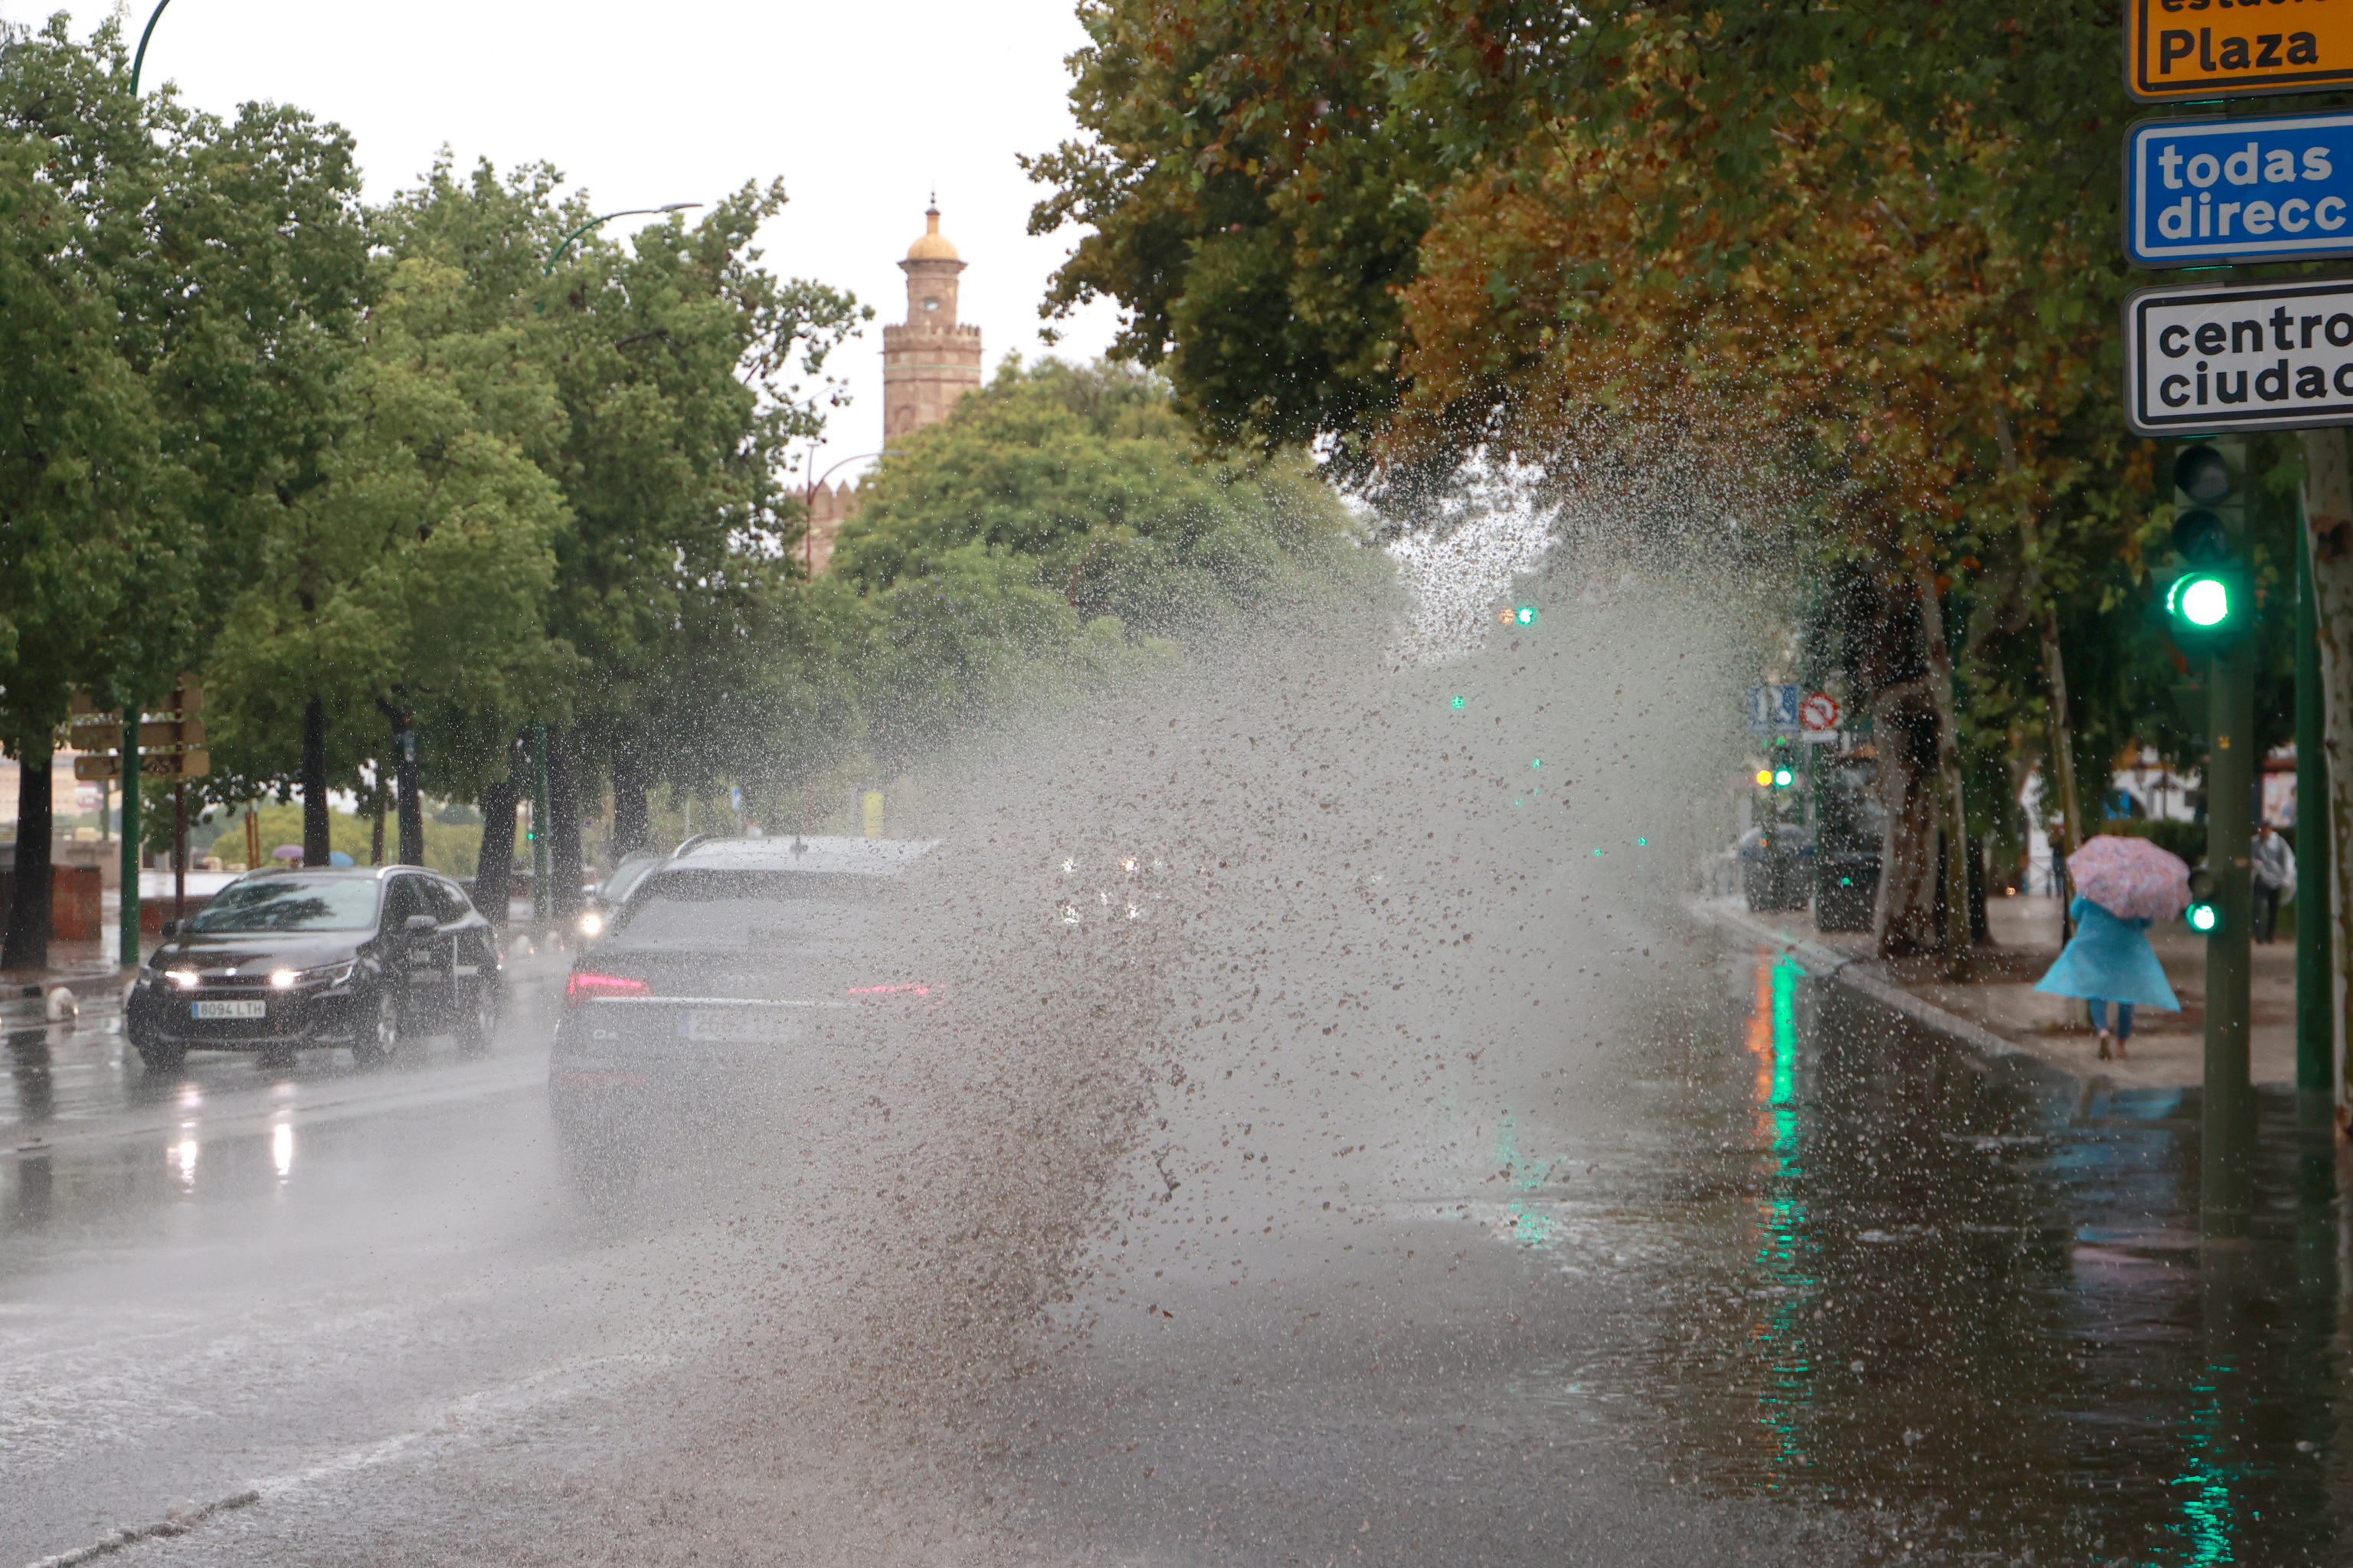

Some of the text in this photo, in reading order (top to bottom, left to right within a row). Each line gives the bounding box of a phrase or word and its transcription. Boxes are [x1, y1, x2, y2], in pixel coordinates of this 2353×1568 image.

[2160, 27, 2319, 74] Plaza
[2158, 142, 2333, 190] todas
[2158, 191, 2347, 240] direcc
[2159, 306, 2353, 358] centro
